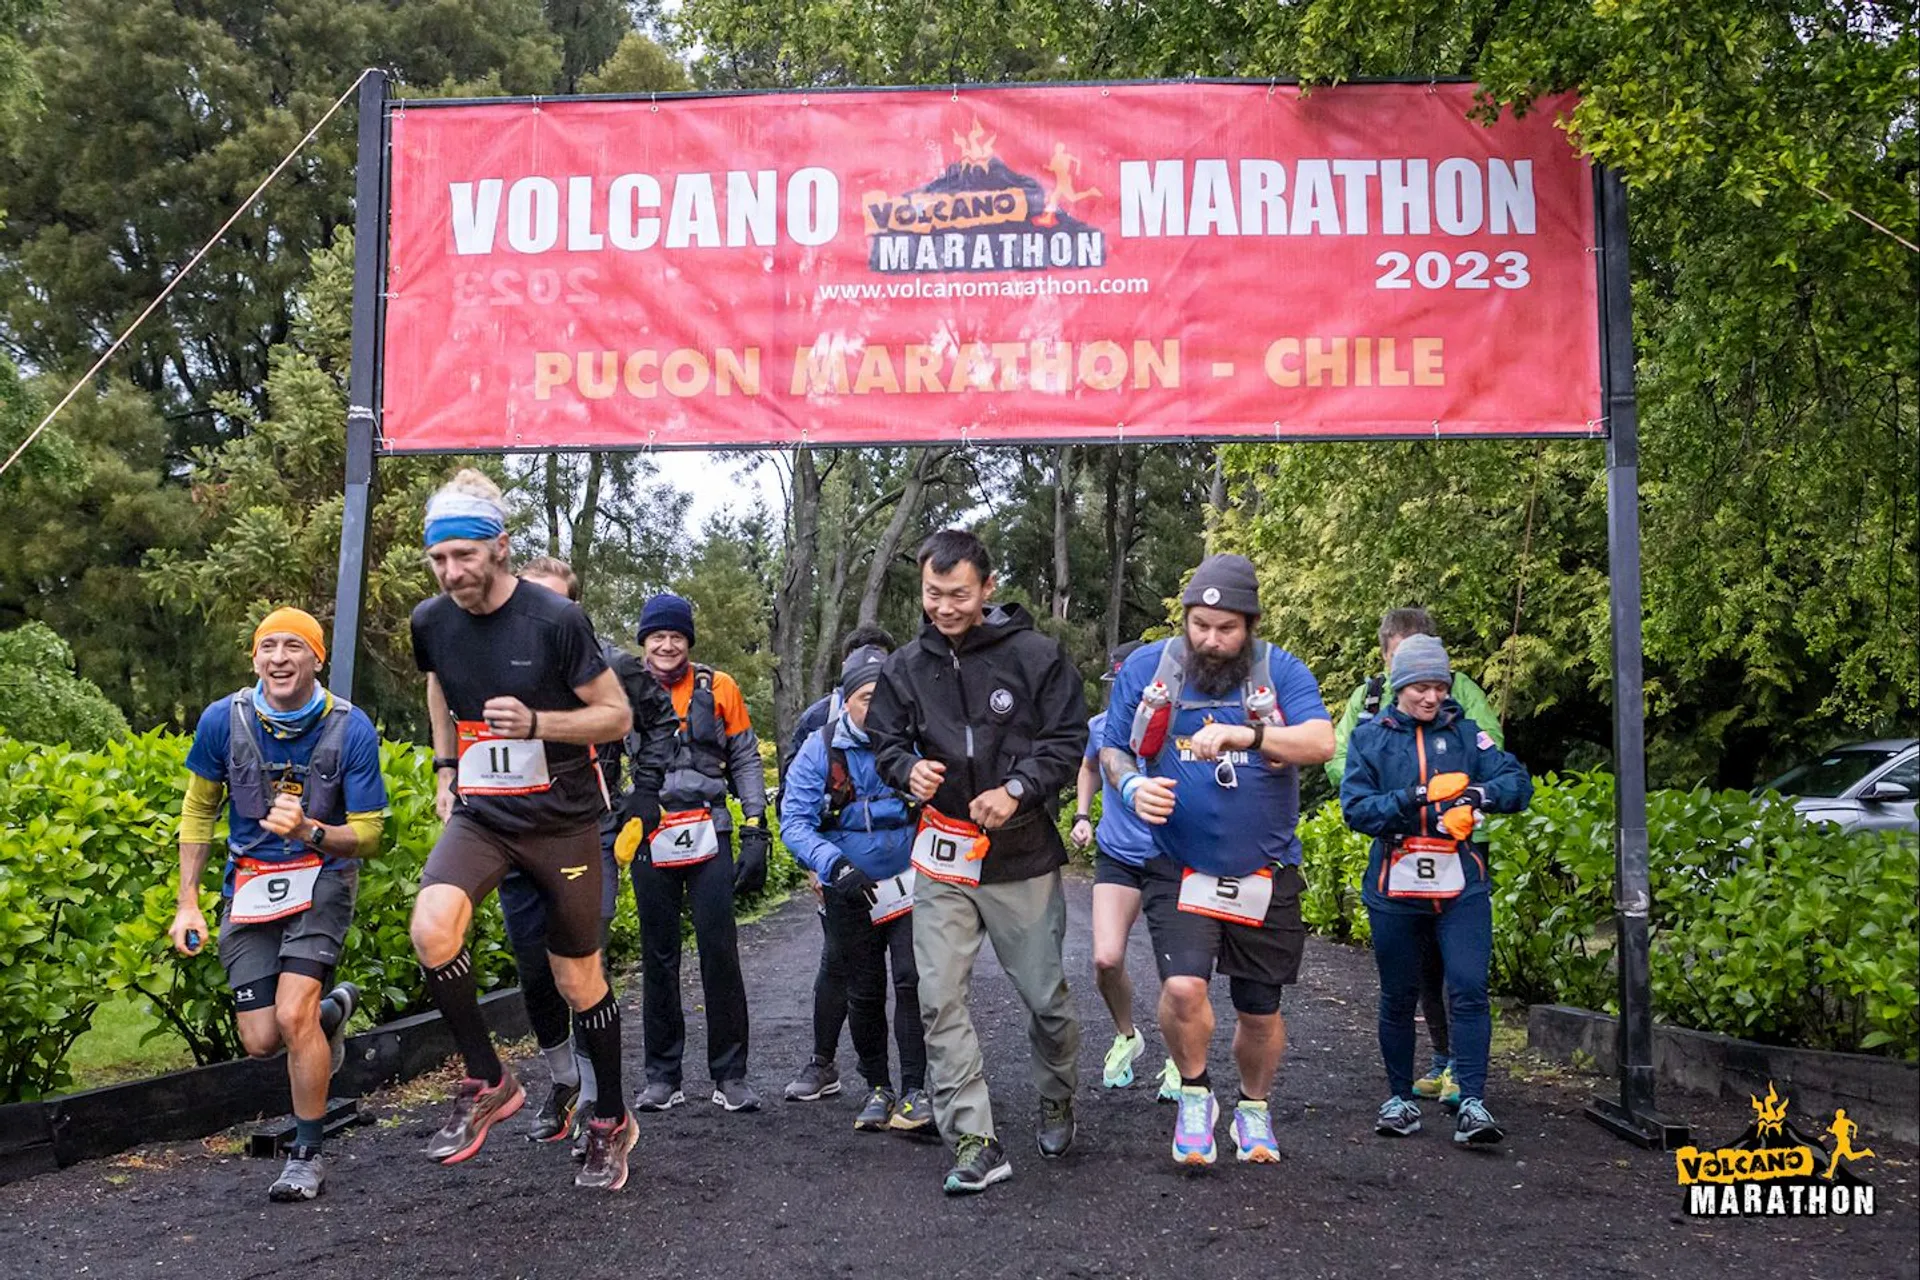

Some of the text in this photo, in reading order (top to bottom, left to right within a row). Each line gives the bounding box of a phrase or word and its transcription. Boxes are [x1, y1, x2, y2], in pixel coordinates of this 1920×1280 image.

[449, 167, 840, 256] VOLCANO
[868, 192, 1016, 229] VOLCANO
[1119, 158, 1537, 238] MARATHON
[879, 231, 1102, 271] MARATHON
[1374, 250, 1532, 290] 2023
[818, 275, 1150, 300] www.volcanomarathon.com
[534, 346, 761, 401] PUCON
[789, 338, 1181, 398] MARATHON
[1264, 336, 1446, 388] CHILE
[489, 746, 511, 774] 11
[674, 829, 694, 848] 4
[930, 834, 957, 862] 10
[1417, 857, 1435, 879] 8
[268, 878, 291, 903] 9
[1216, 876, 1240, 900] 5
